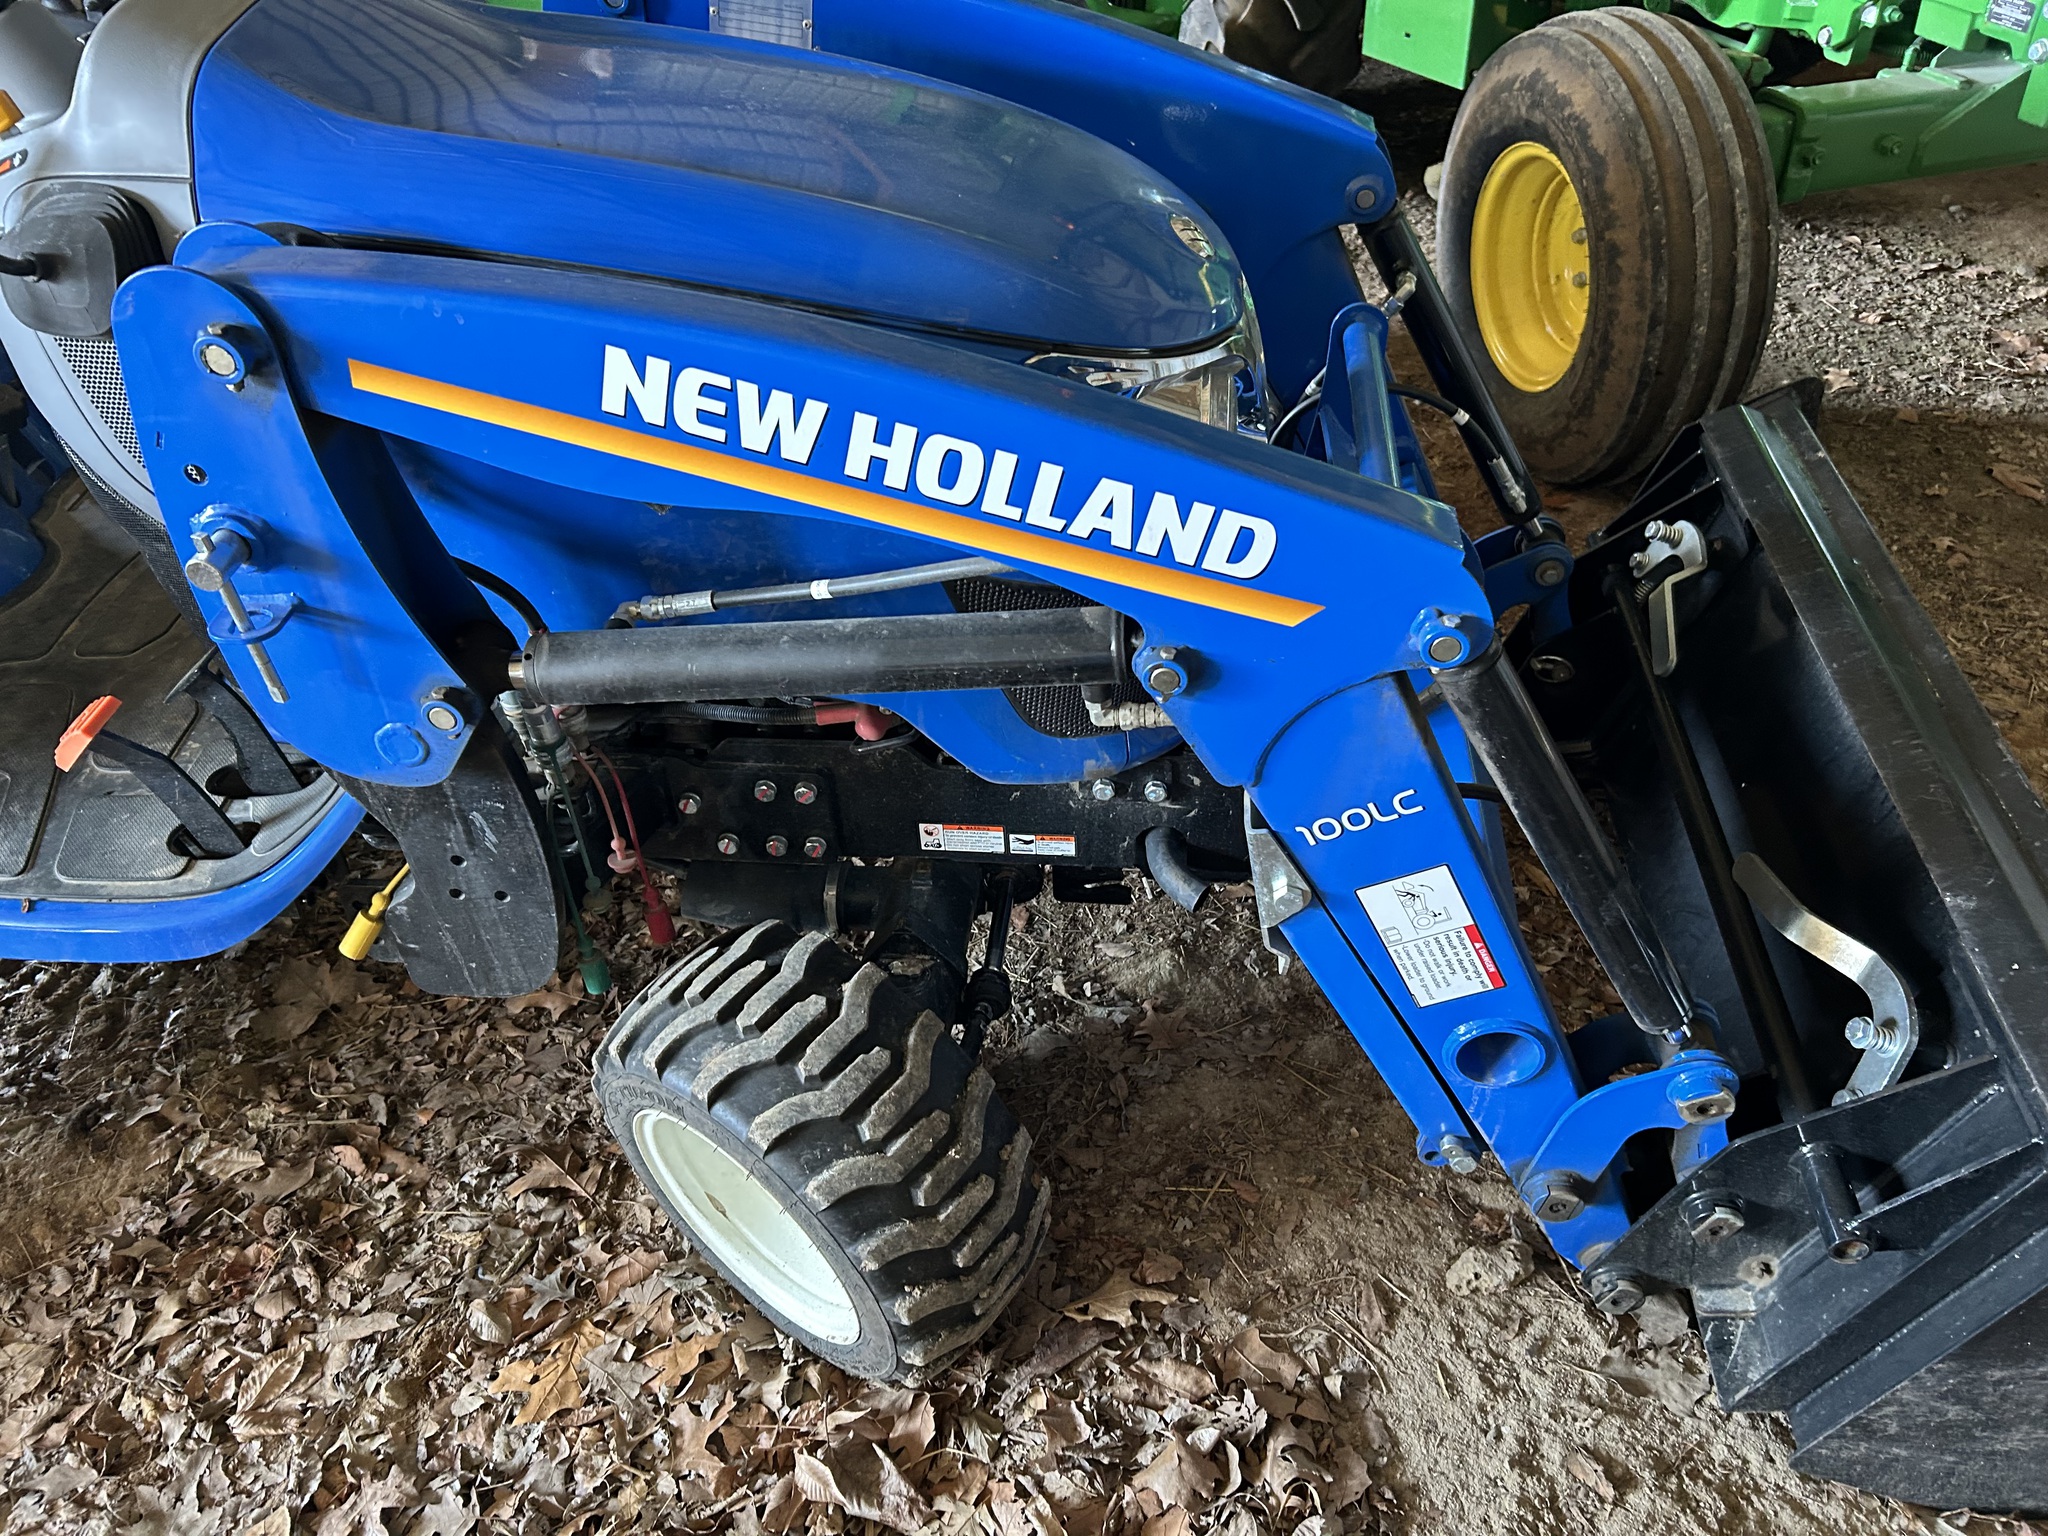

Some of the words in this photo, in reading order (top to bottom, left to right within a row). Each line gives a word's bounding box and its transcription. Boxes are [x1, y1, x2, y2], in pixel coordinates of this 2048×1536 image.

[601, 345, 829, 466] NEW
[843, 410, 1278, 580] HOLLAND
[1295, 788, 1426, 846] 100LC
[1392, 948, 1404, 962] when
[1399, 962, 1414, 981] parked.
[1413, 942, 1426, 958] under
[1421, 958, 1434, 973] raised
[1426, 948, 1436, 957] not
[1431, 957, 1442, 969] walk
[1440, 975, 1451, 987] work
[1432, 935, 1449, 957] serious
[1442, 958, 1459, 976] injury.
[1443, 932, 1457, 950] result
[1455, 957, 1469, 974] death
[1453, 930, 1469, 950] Failure
[1466, 957, 1483, 979] comply
[1478, 979, 1489, 989] will
[1479, 949, 1495, 972] DANGER
[1409, 961, 1423, 977] loader
[1420, 983, 1435, 1000] ground
